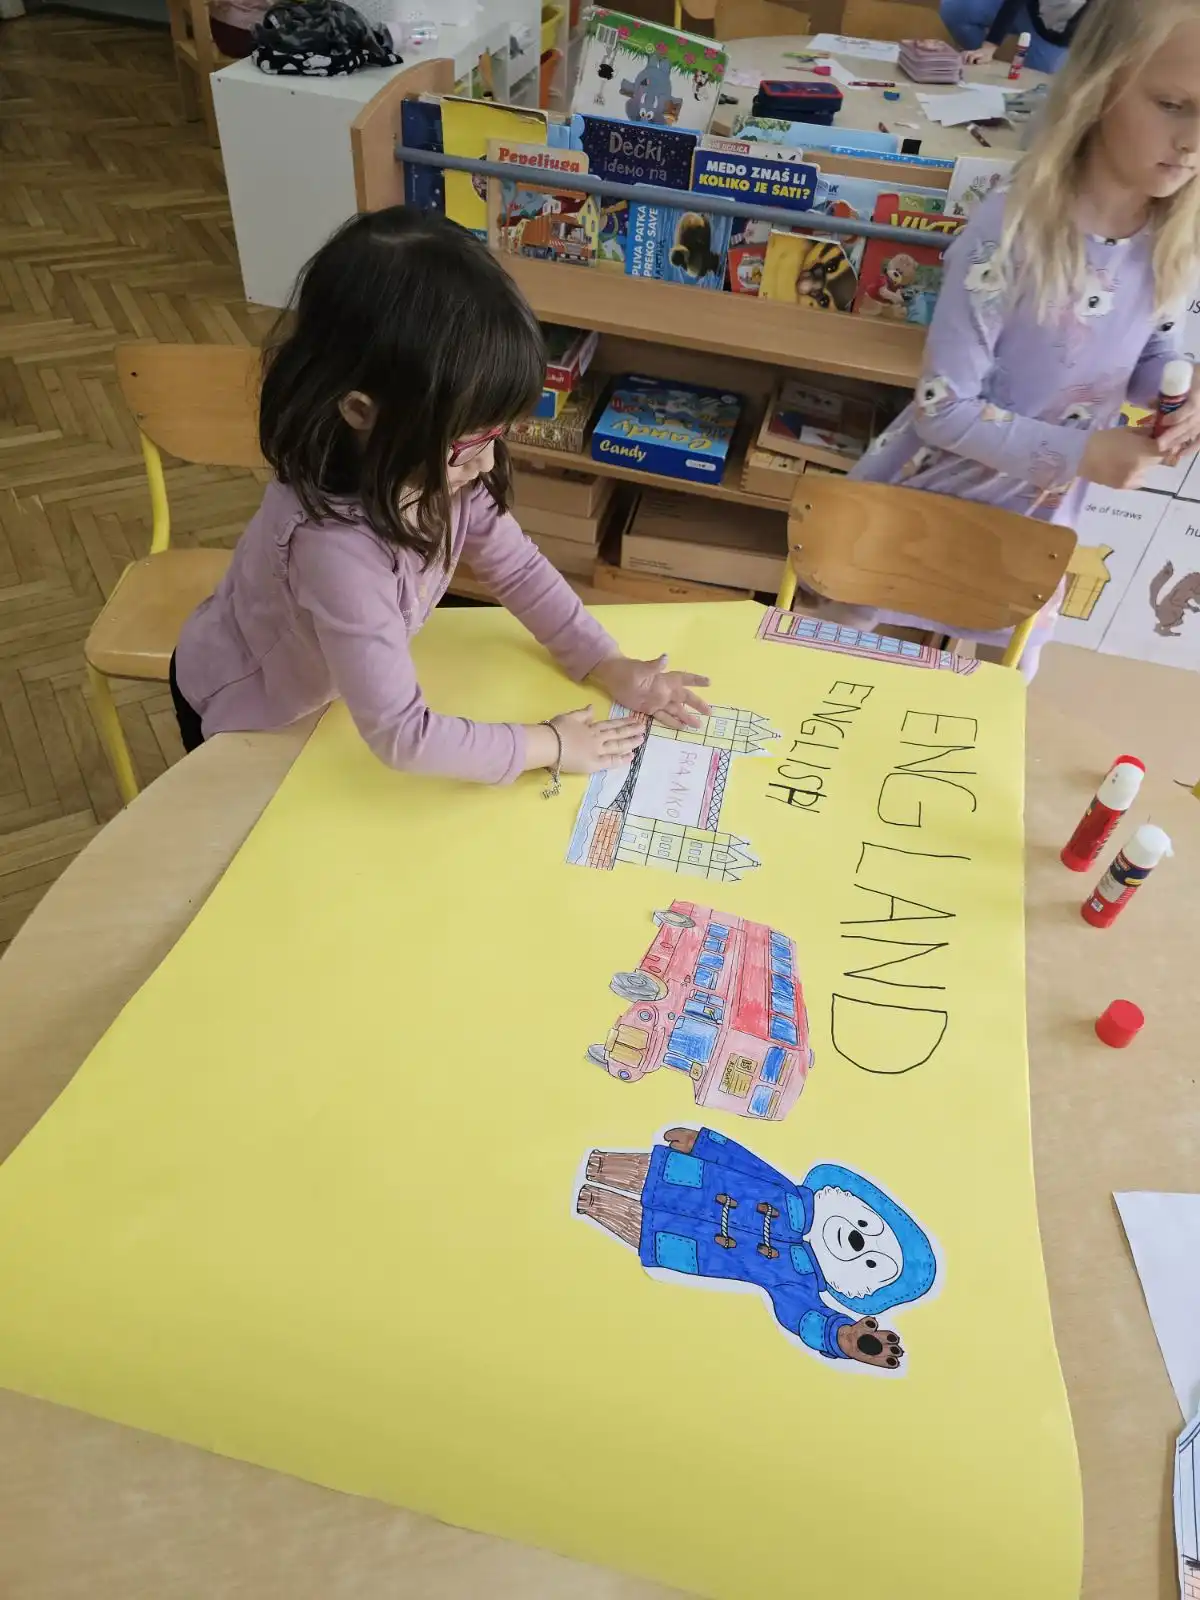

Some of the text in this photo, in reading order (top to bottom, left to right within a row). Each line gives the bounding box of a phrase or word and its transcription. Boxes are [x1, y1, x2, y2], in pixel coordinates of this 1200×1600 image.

[498, 147, 580, 173] Pepeljuga
[609, 131, 666, 166] Dečki,
[604, 159, 667, 182] idemo na
[706, 160, 807, 185] MEDO ZNAŠ LI
[699, 173, 811, 200] KOLIKO JE SATI?
[632, 205, 647, 275] PLIVA PATKA
[643, 207, 658, 277] PREKO SAVE
[599, 439, 647, 463] Candy
[1111, 507, 1142, 521] straws
[830, 710, 979, 1075] ENGLAND
